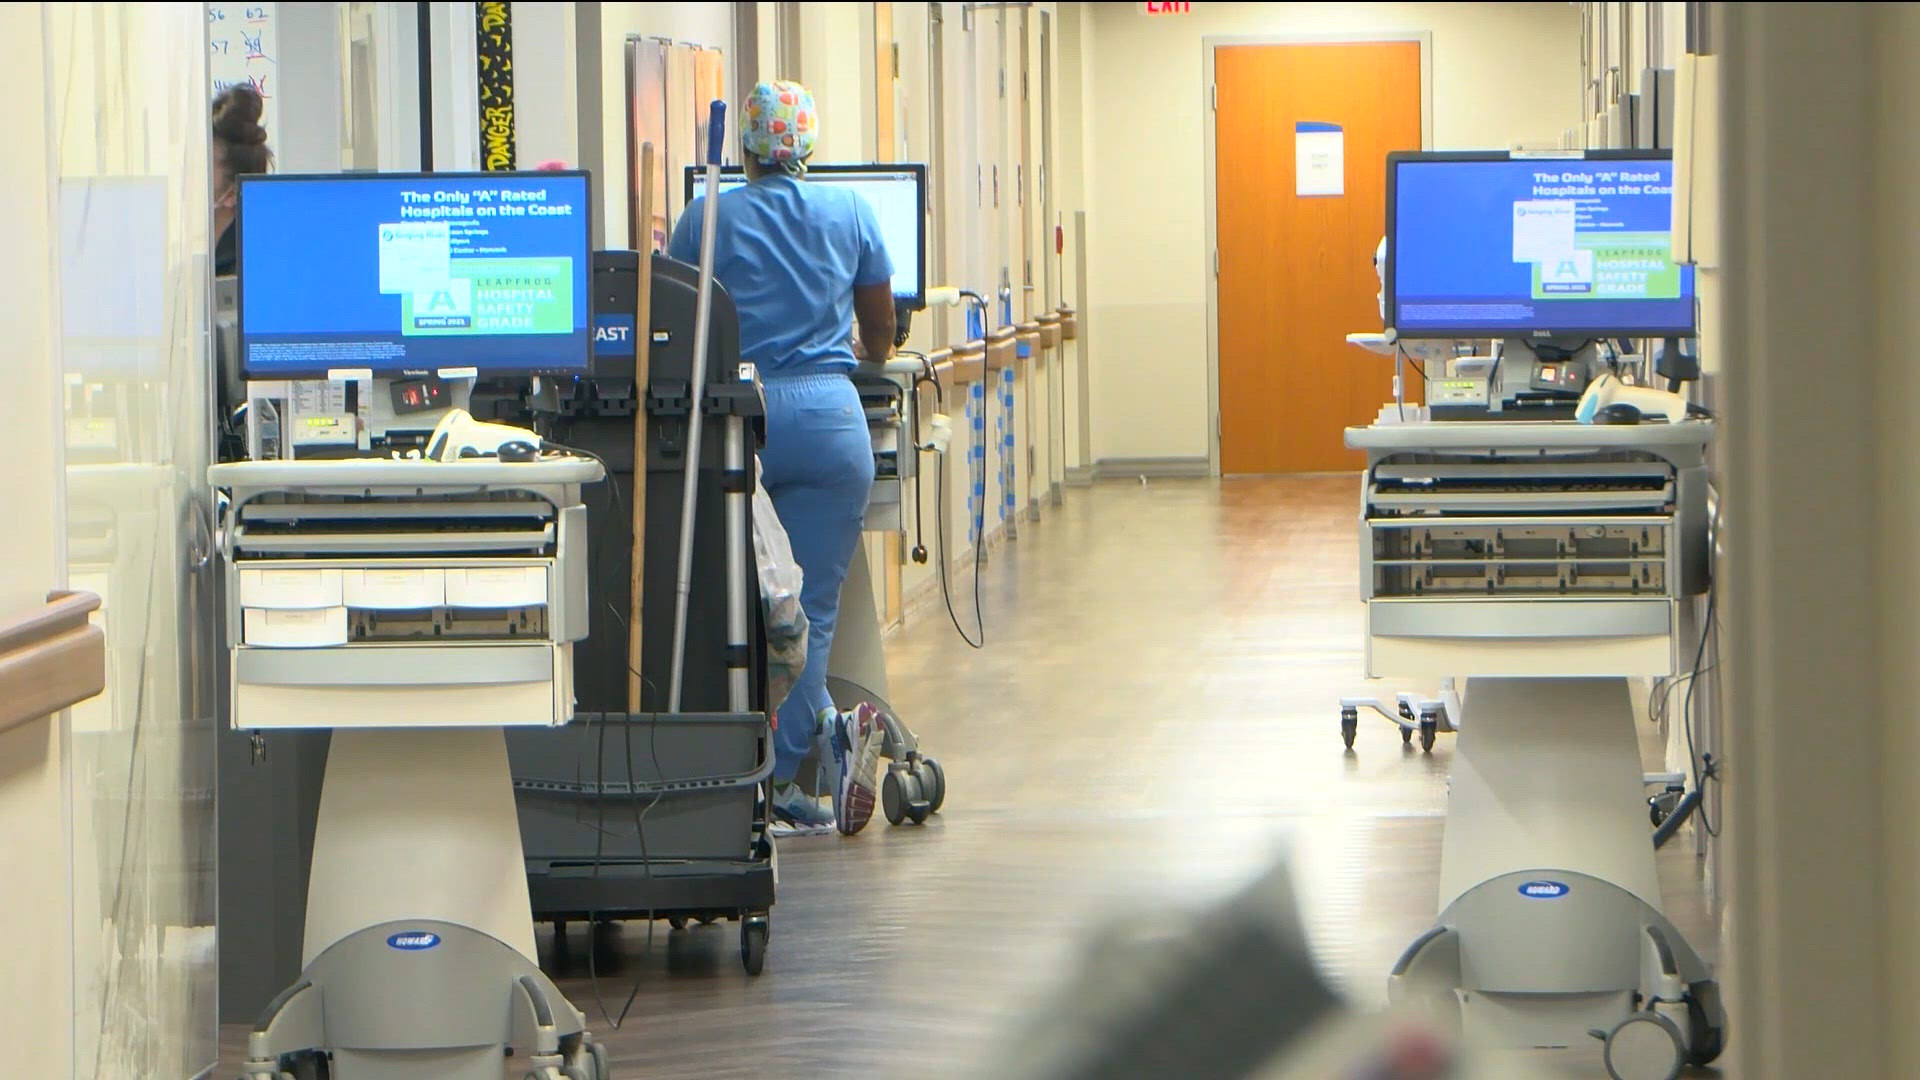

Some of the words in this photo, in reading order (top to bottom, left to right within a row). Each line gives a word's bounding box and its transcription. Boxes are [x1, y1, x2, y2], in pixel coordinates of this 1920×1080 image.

[485, 104, 513, 171] DANGER
[1533, 172, 1559, 183] The
[1561, 172, 1593, 184] Only
[1620, 171, 1660, 182] Rated
[400, 191, 431, 203] The
[433, 190, 470, 204] Only
[501, 189, 547, 202] Rated
[1532, 185, 1596, 197] Hospitals
[1598, 186, 1616, 195] on
[1618, 185, 1641, 195] the
[400, 205, 474, 219] Hospitals
[476, 206, 497, 216] on
[499, 204, 525, 216] the
[528, 204, 572, 216] Coast
[1597, 260, 1665, 270] HOSPITAL
[477, 278, 552, 286] LEAPFROG
[1597, 272, 1648, 283] SAFETY
[477, 289, 555, 300] HOSPITAL
[1597, 284, 1646, 294] GRADE
[428, 291, 457, 311] A
[477, 303, 533, 315] SAFETY
[477, 317, 534, 329] GRADE
